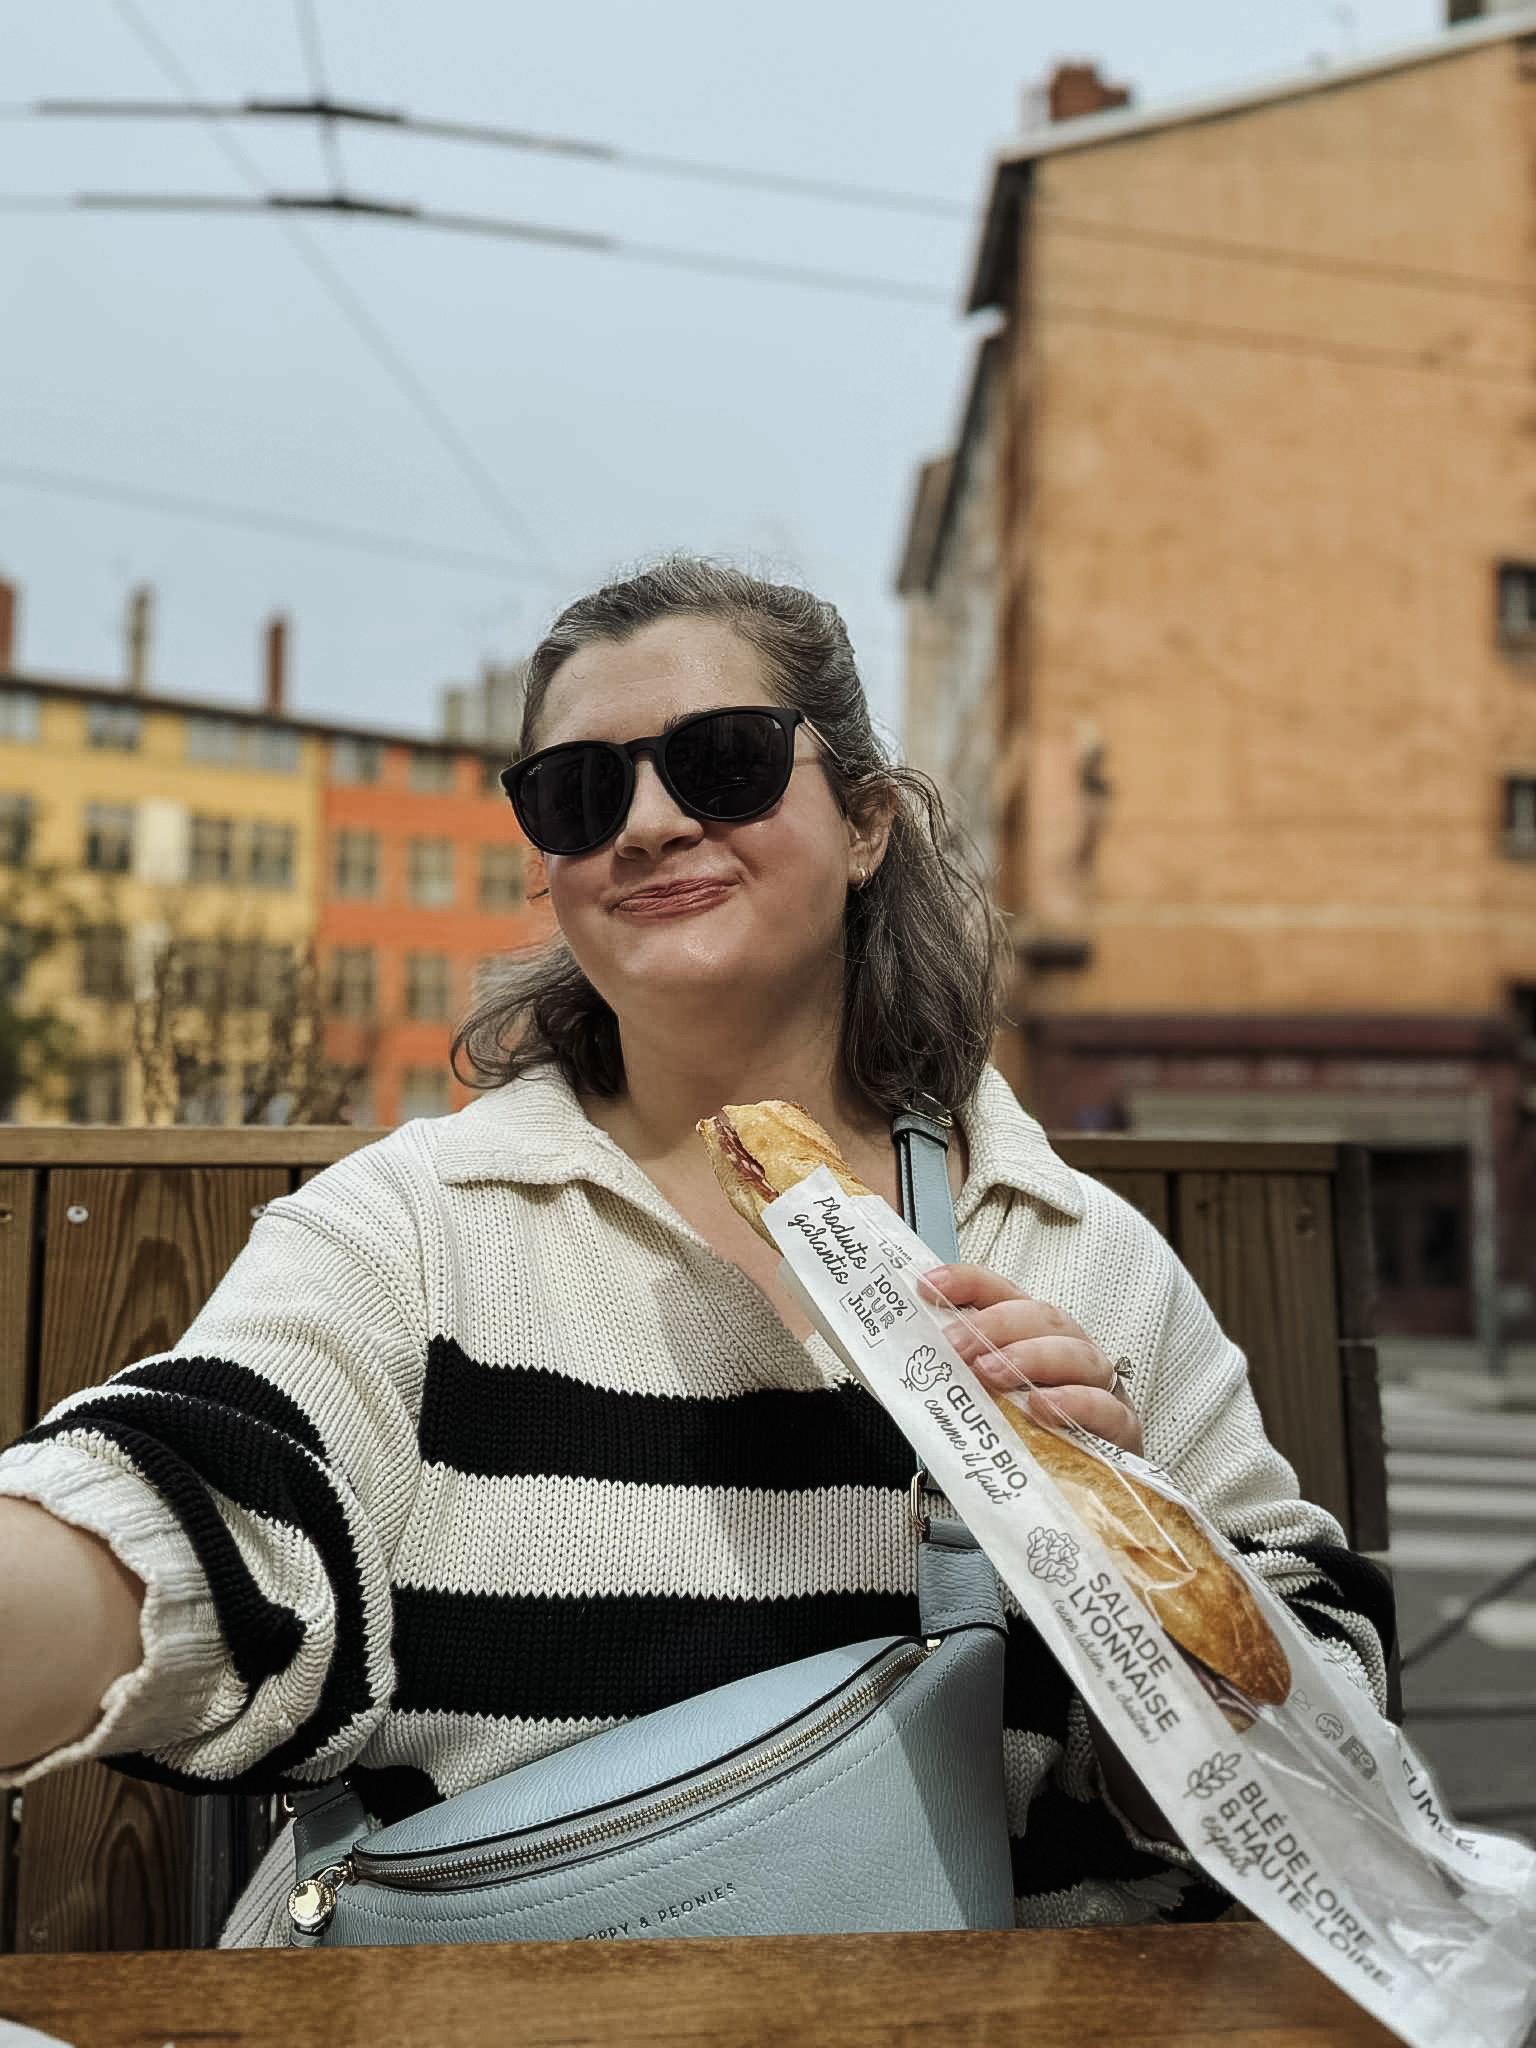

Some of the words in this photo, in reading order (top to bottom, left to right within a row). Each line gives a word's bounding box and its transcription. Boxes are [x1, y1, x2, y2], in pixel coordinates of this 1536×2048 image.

[788, 1213, 848, 1285] garantis
[813, 1197, 869, 1270] Produits
[848, 1295, 881, 1336] Jules
[861, 1284, 896, 1329] PUR
[873, 1274, 909, 1316] 100%
[924, 1400, 967, 1450] comme
[965, 1467, 1014, 1504] faut
[946, 1385, 999, 1450] ŒUFS
[990, 1449, 1027, 1497] BIO,
[1069, 1585, 1180, 1732] LYONNAISE
[1089, 1572, 1172, 1678] SALADE
[1219, 1798, 1242, 1822] &
[1238, 1781, 1288, 1836] BLÉ
[1274, 1832, 1311, 1875] DE
[1301, 1872, 1376, 1949] LOIRE
[639, 1917, 651, 1929] &
[657, 1882, 736, 1922] PEONIES
